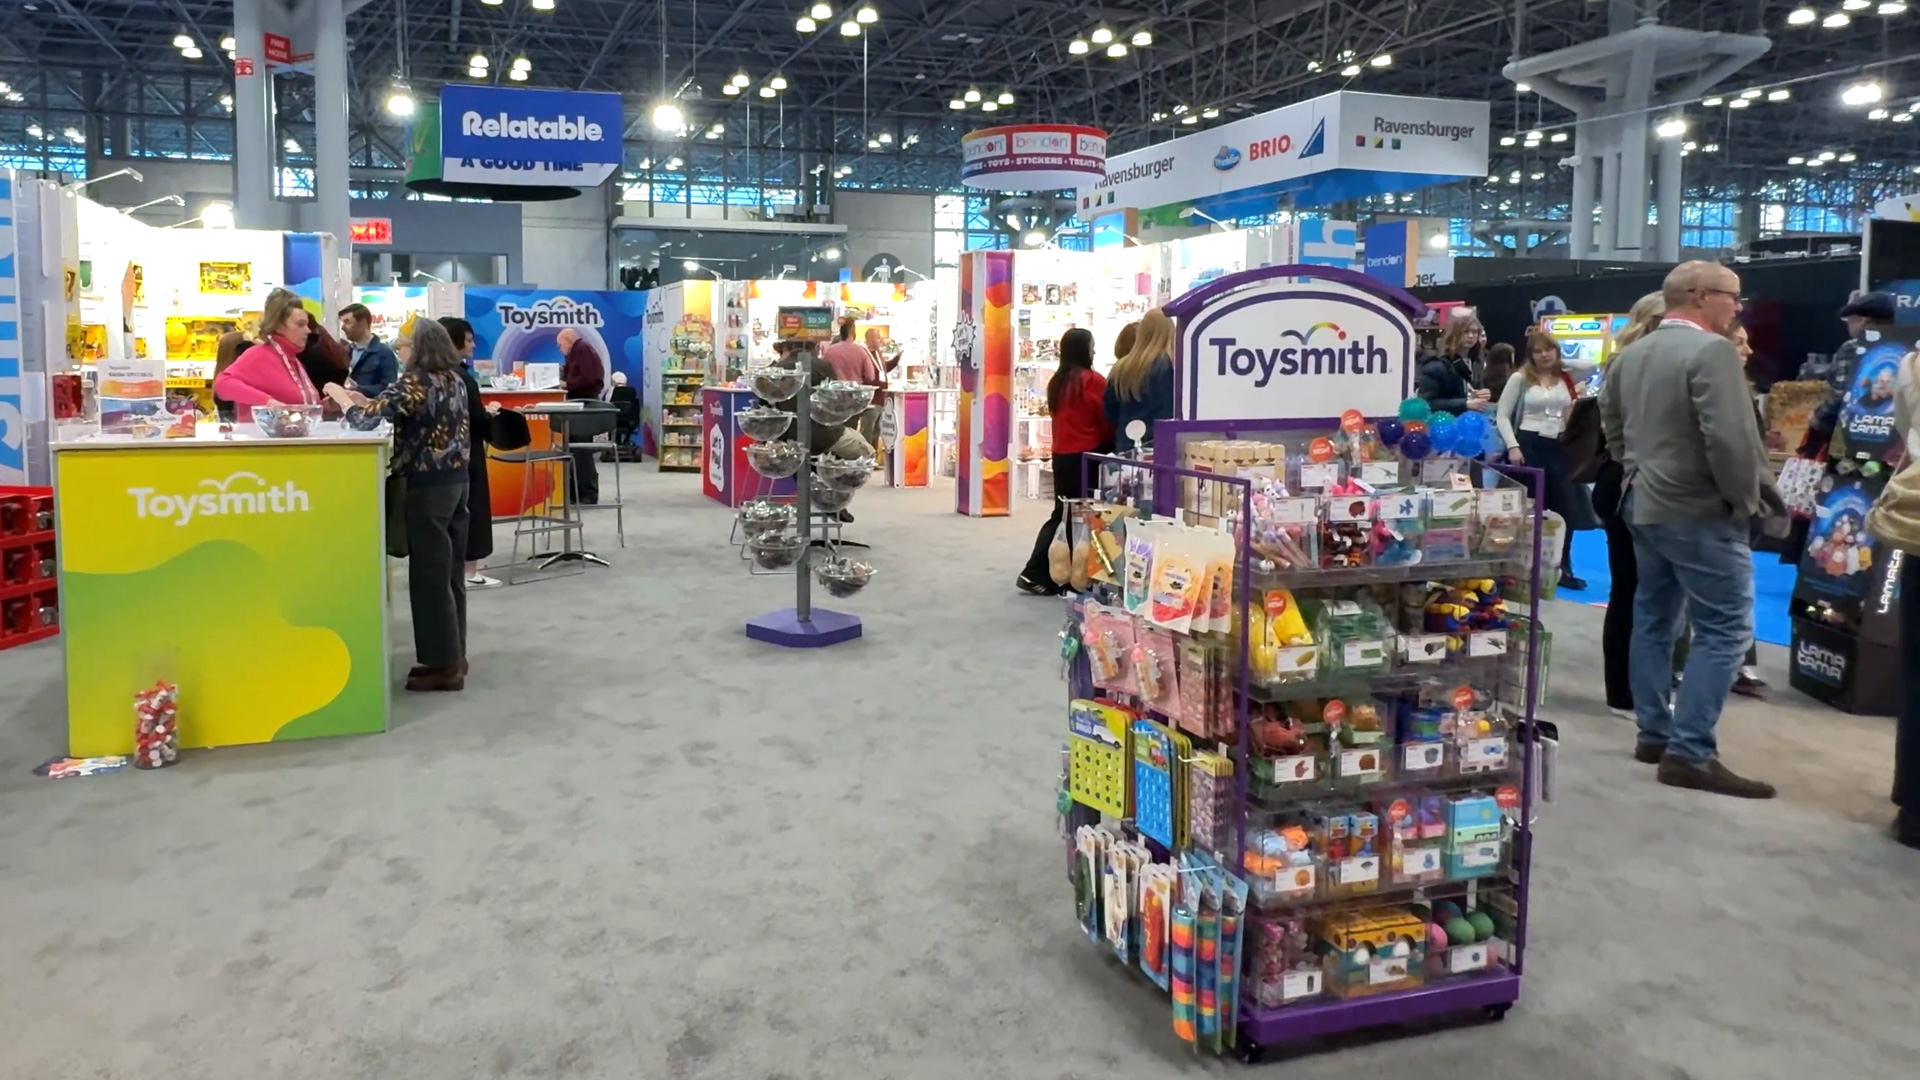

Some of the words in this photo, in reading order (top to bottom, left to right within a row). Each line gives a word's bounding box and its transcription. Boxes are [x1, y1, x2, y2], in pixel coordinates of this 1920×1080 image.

[1374, 116, 1475, 141] Ravensburger
[1249, 134, 1291, 161] BRIO
[480, 159, 536, 170] GOOD
[543, 161, 584, 172] TIME
[988, 158, 1010, 168] TOYS
[1016, 157, 1063, 166] STICKERS
[1069, 158, 1096, 168] TREATS
[1094, 156, 1176, 190] avensburger
[1367, 253, 1402, 268] bendon
[499, 302, 598, 330] Toysmith
[1209, 330, 1388, 388] Toysmith
[127, 480, 310, 527] Toysmith
